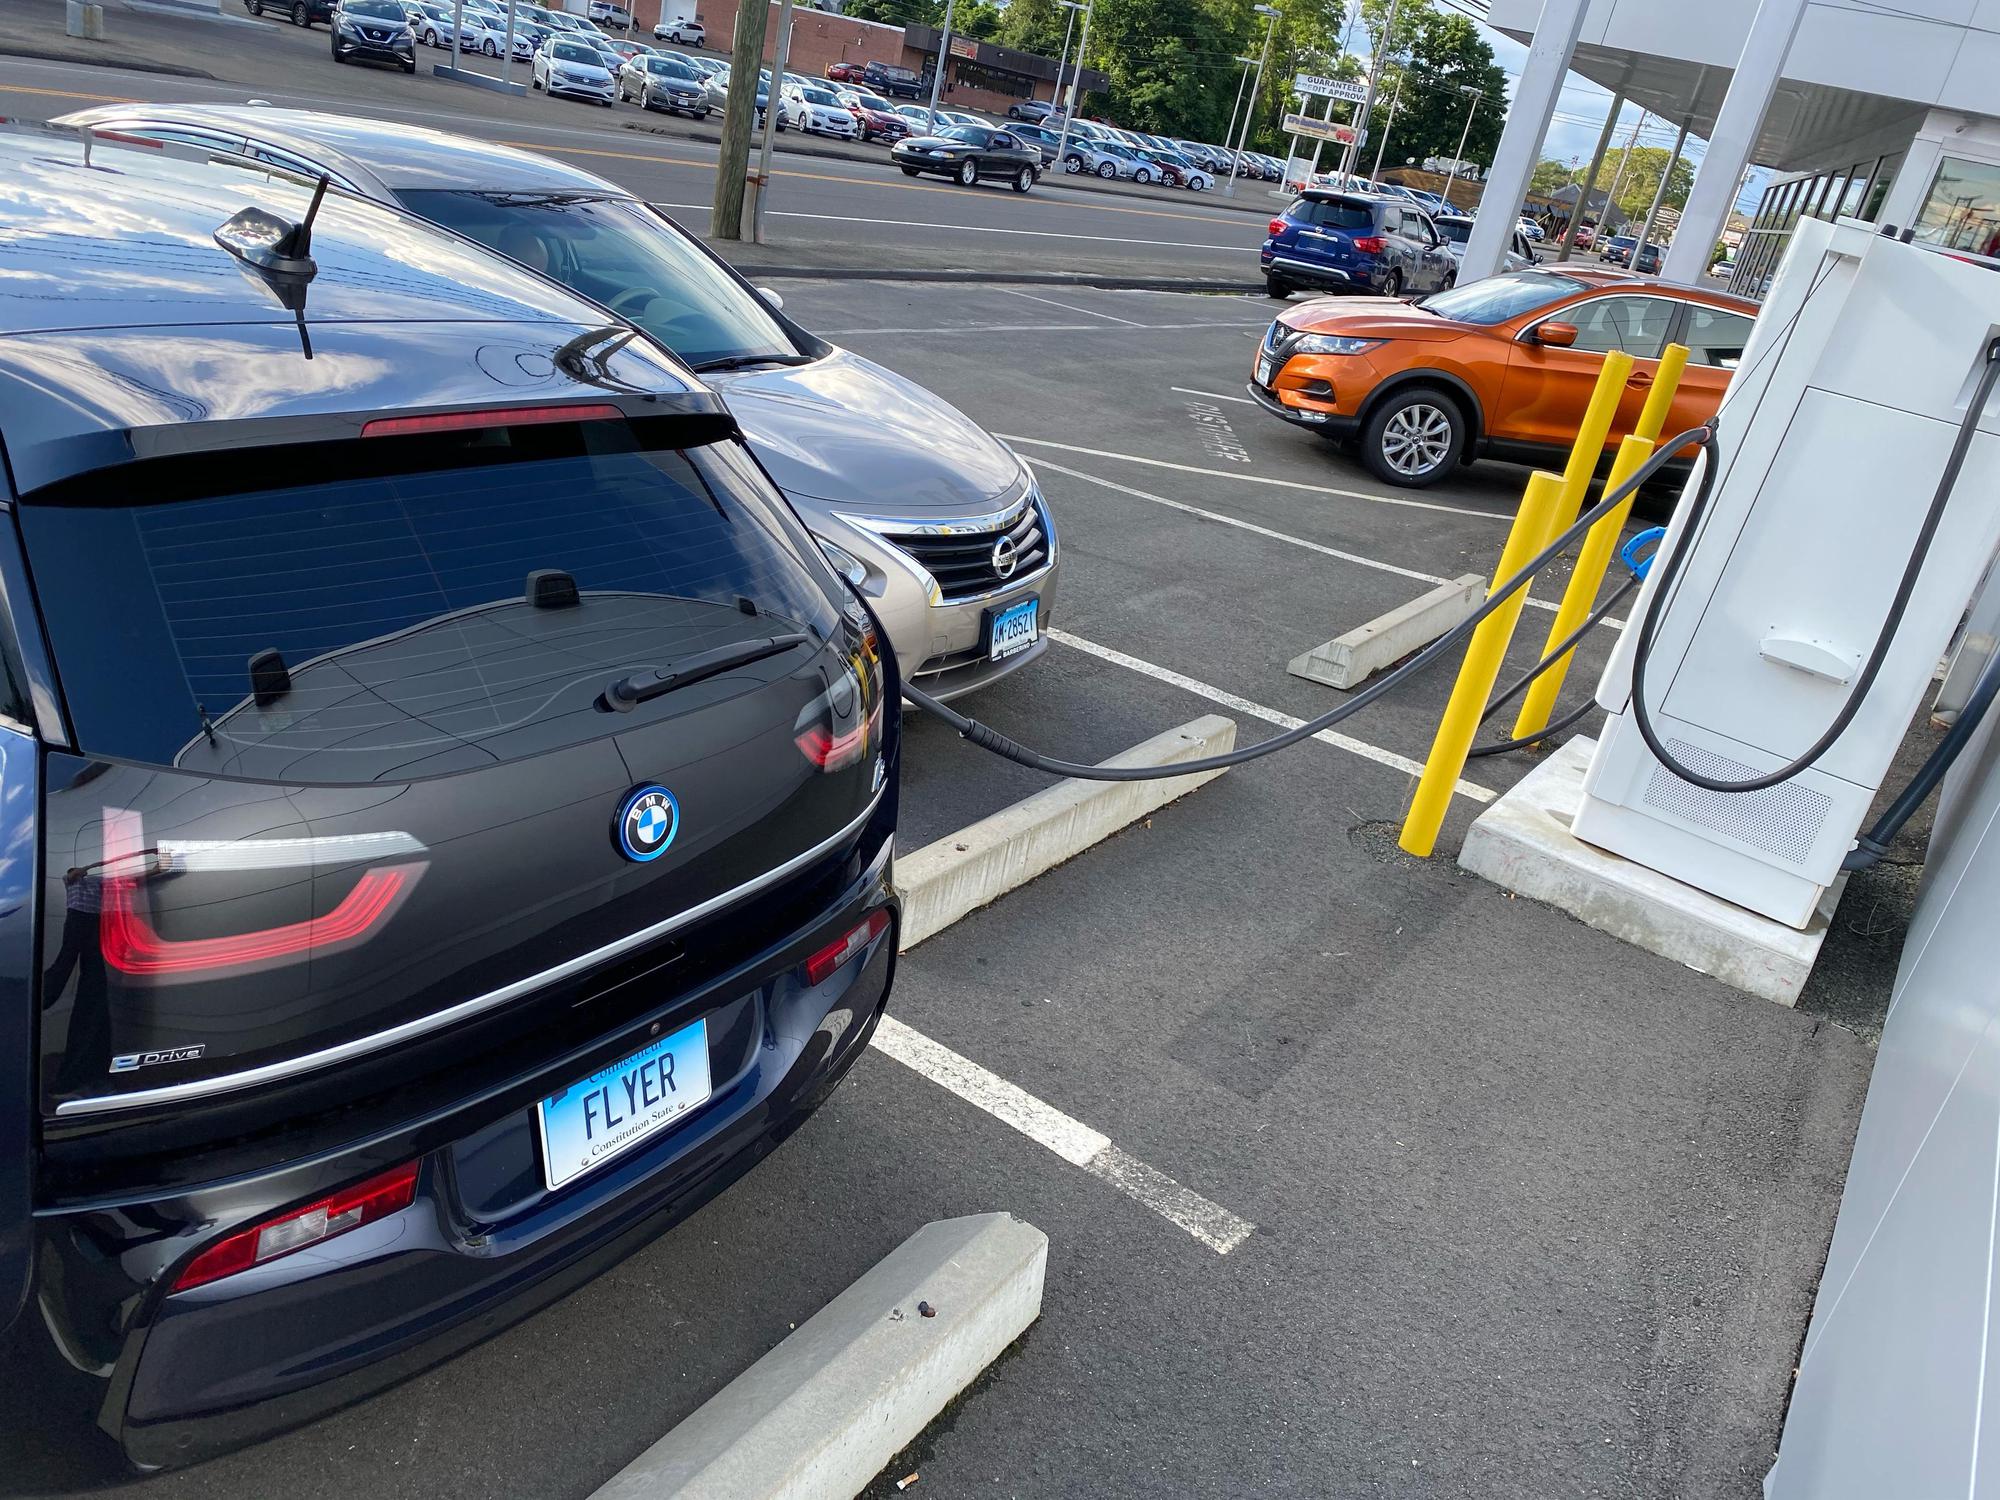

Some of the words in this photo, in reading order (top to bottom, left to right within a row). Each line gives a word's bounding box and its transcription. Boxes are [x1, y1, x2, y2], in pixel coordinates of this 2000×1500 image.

[1307, 76, 1364, 93] GUARANTEED
[1328, 88, 1367, 102] APPROVA
[632, 796, 670, 821] BMW
[583, 1052, 676, 1141] FLYER
[591, 1119, 650, 1156] Constitution
[651, 1105, 674, 1122] State
